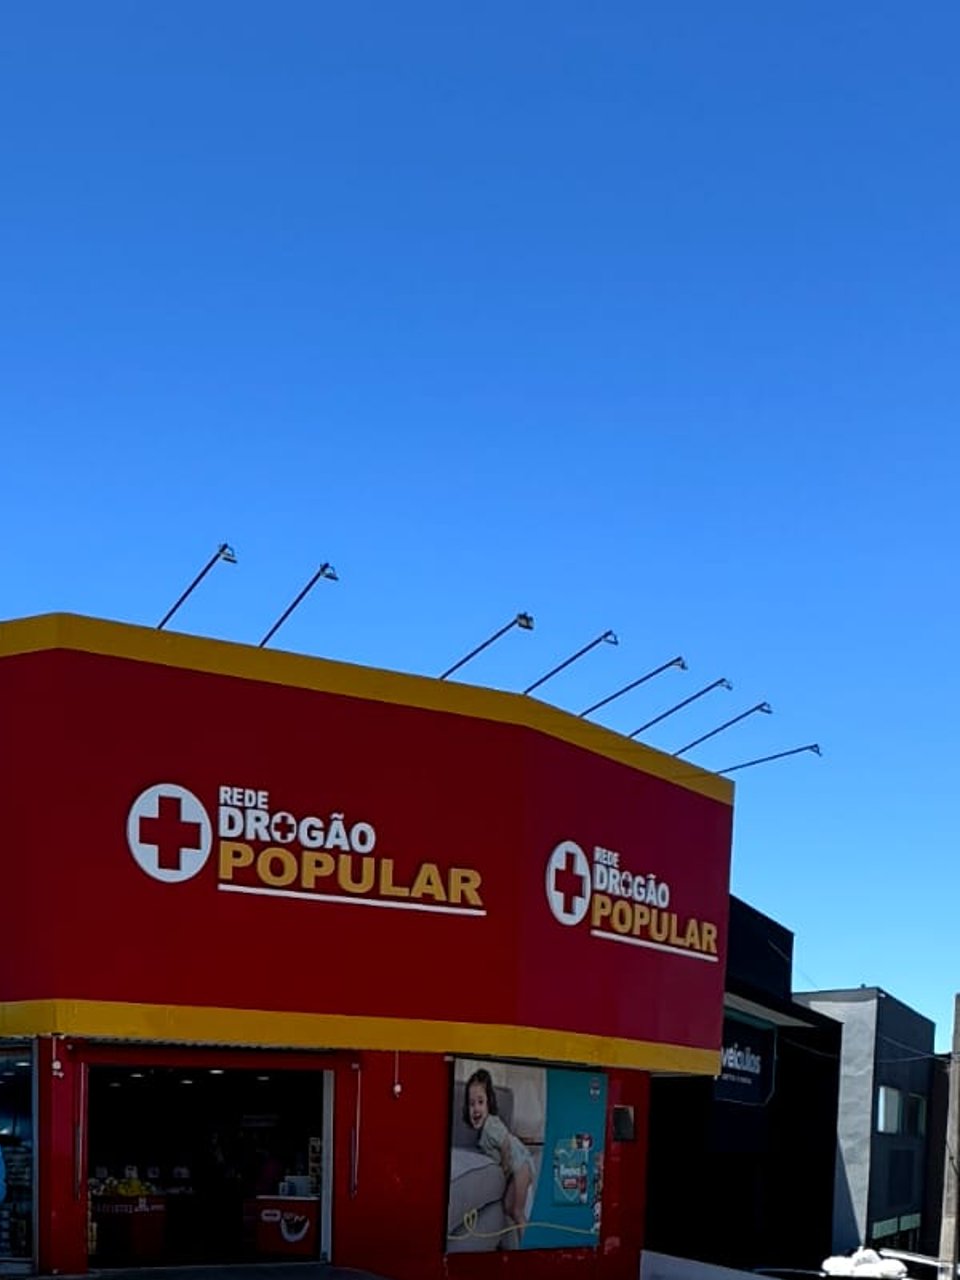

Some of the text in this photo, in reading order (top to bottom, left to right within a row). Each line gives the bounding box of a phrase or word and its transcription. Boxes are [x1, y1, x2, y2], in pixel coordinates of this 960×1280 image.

[218, 785, 269, 809] REDE
[218, 805, 377, 854] DROGÃO
[218, 840, 484, 906] POPULAR
[593, 845, 620, 868] REDE
[593, 862, 670, 909] DROGÃO
[591, 892, 718, 954] POPULAR
